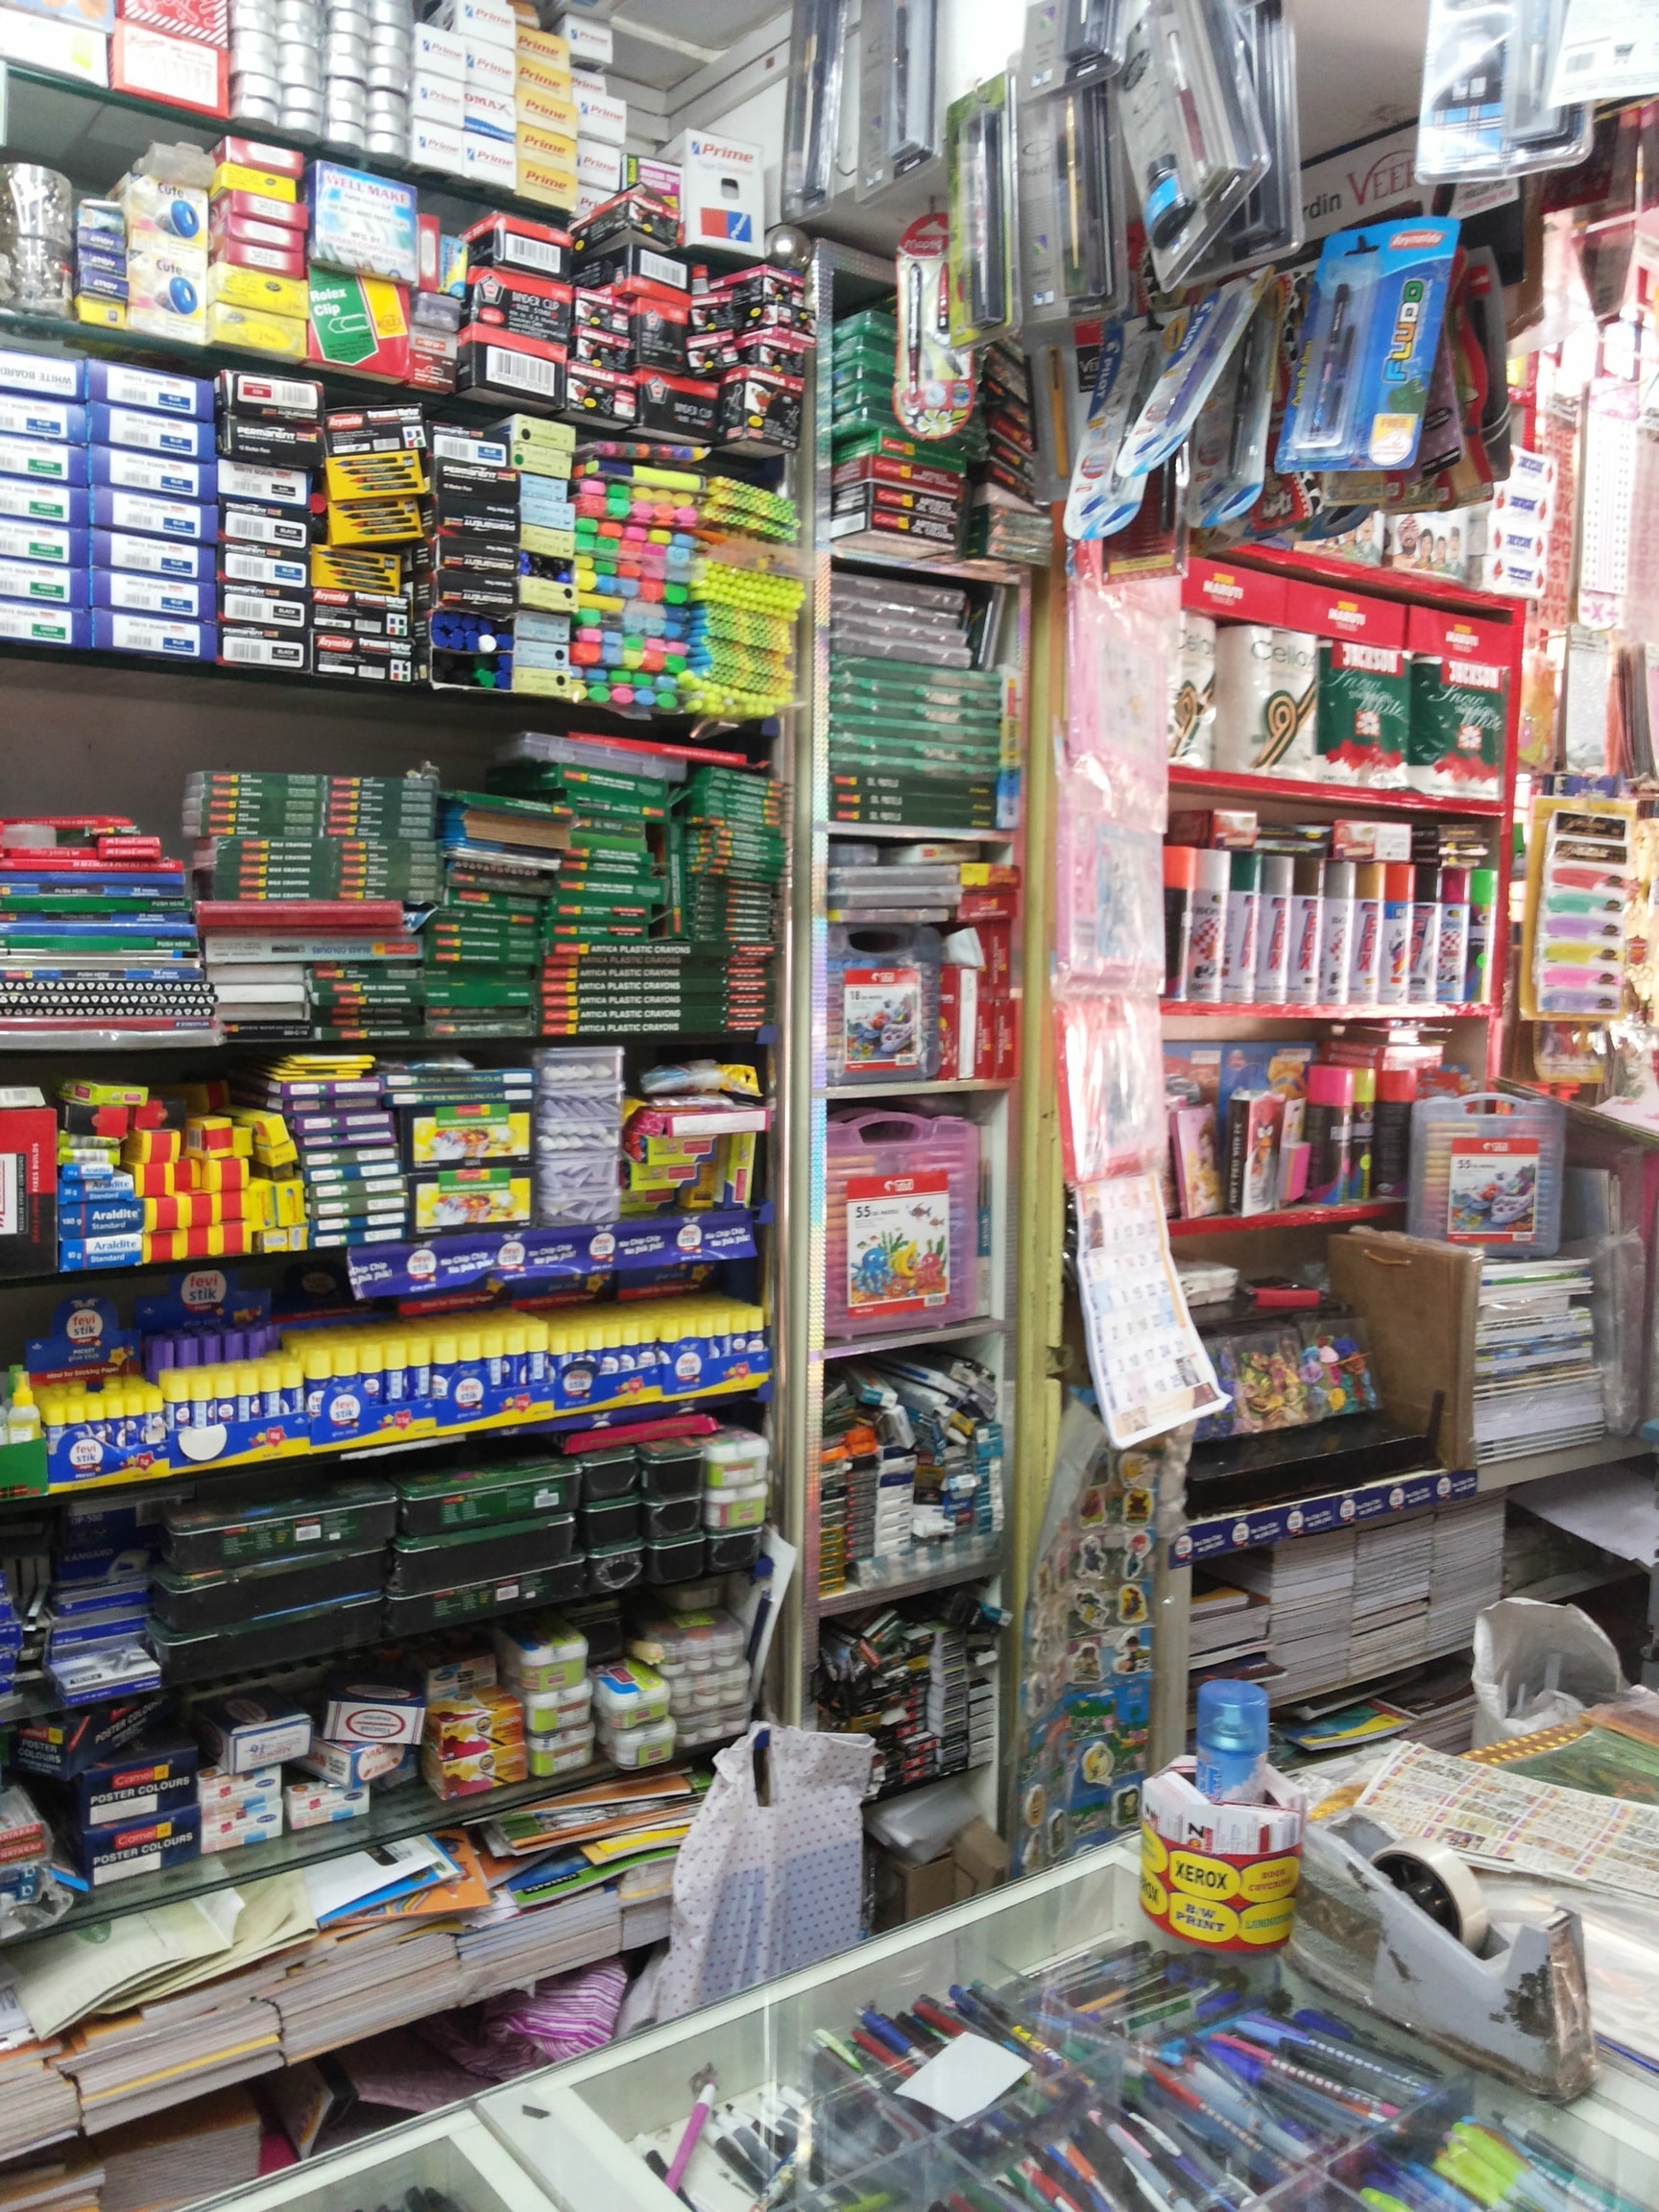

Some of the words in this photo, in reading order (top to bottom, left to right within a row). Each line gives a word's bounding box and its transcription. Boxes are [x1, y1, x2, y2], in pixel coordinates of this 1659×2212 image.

[475, 8, 512, 25] Prime
[579, 31, 608, 44] Prime
[432, 42, 462, 60] Prime
[517, 35, 559, 56] Prime
[477, 58, 512, 76] Prime
[519, 66, 561, 89] Prime
[570, 77, 604, 93] Prime
[525, 99, 566, 121] Prime
[590, 105, 623, 122] Prime
[428, 138, 459, 153] Prime
[524, 134, 566, 155] Prime
[477, 150, 513, 167] Prime
[703, 143, 754, 163] Prime
[583, 156, 616, 173] Prime
[526, 170, 566, 190] Prime
[157, 182, 184, 198] Cute
[326, 175, 363, 192] WELL
[369, 185, 408, 204] MAKE
[1303, 193, 1341, 219] rdin
[156, 259, 182, 275] Cute
[310, 289, 347, 302] Rolex
[313, 302, 341, 318] Clip
[327, 415, 364, 429] Reynolds
[314, 590, 349, 605] Reynolds
[318, 637, 353, 651] Reynolds
[619, 946, 653, 954] PLASTIC
[655, 946, 691, 954] CRAYONS
[609, 969, 641, 977] PLASTIC
[609, 996, 642, 1004] PLASTIC
[850, 990, 861, 1000] 18
[581, 1010, 607, 1019] ARTICA
[579, 1023, 606, 1032] ARTICA
[607, 1023, 640, 1032] PLASTIC
[92, 1210, 138, 1220] Araldite
[855, 1206, 871, 1218] 55
[94, 1240, 137, 1250] Araldite
[90, 1255, 126, 1263] Standard
[453, 1256, 470, 1264] Chip
[470, 1252, 489, 1261] Chip
[370, 1262, 388, 1271] Chip
[189, 1274, 218, 1287] fevi
[189, 1286, 217, 1302] stik
[73, 1316, 95, 1327] fevi
[73, 1326, 95, 1336] stik
[75, 1367, 101, 1377] Sticking
[102, 1366, 119, 1375] Paper
[335, 1400, 355, 1410] fevi
[335, 1409, 353, 1419] stik
[76, 1445, 97, 1455] fevi
[76, 1454, 96, 1464] stik
[64, 1548, 113, 1562] KANGARO
[21, 1739, 58, 1753] POSTER
[17, 1746, 61, 1765] COLOURS
[114, 1770, 155, 1787] Camel
[90, 1784, 135, 1806] POSTER
[138, 1776, 190, 1797] COLOURS
[118, 1828, 156, 1846] Camel
[93, 1847, 139, 1866] POSTER
[141, 1832, 193, 1855] COLOURS
[1175, 1861, 1229, 1890] XEROX
[1175, 1911, 1226, 1933] PRINT
